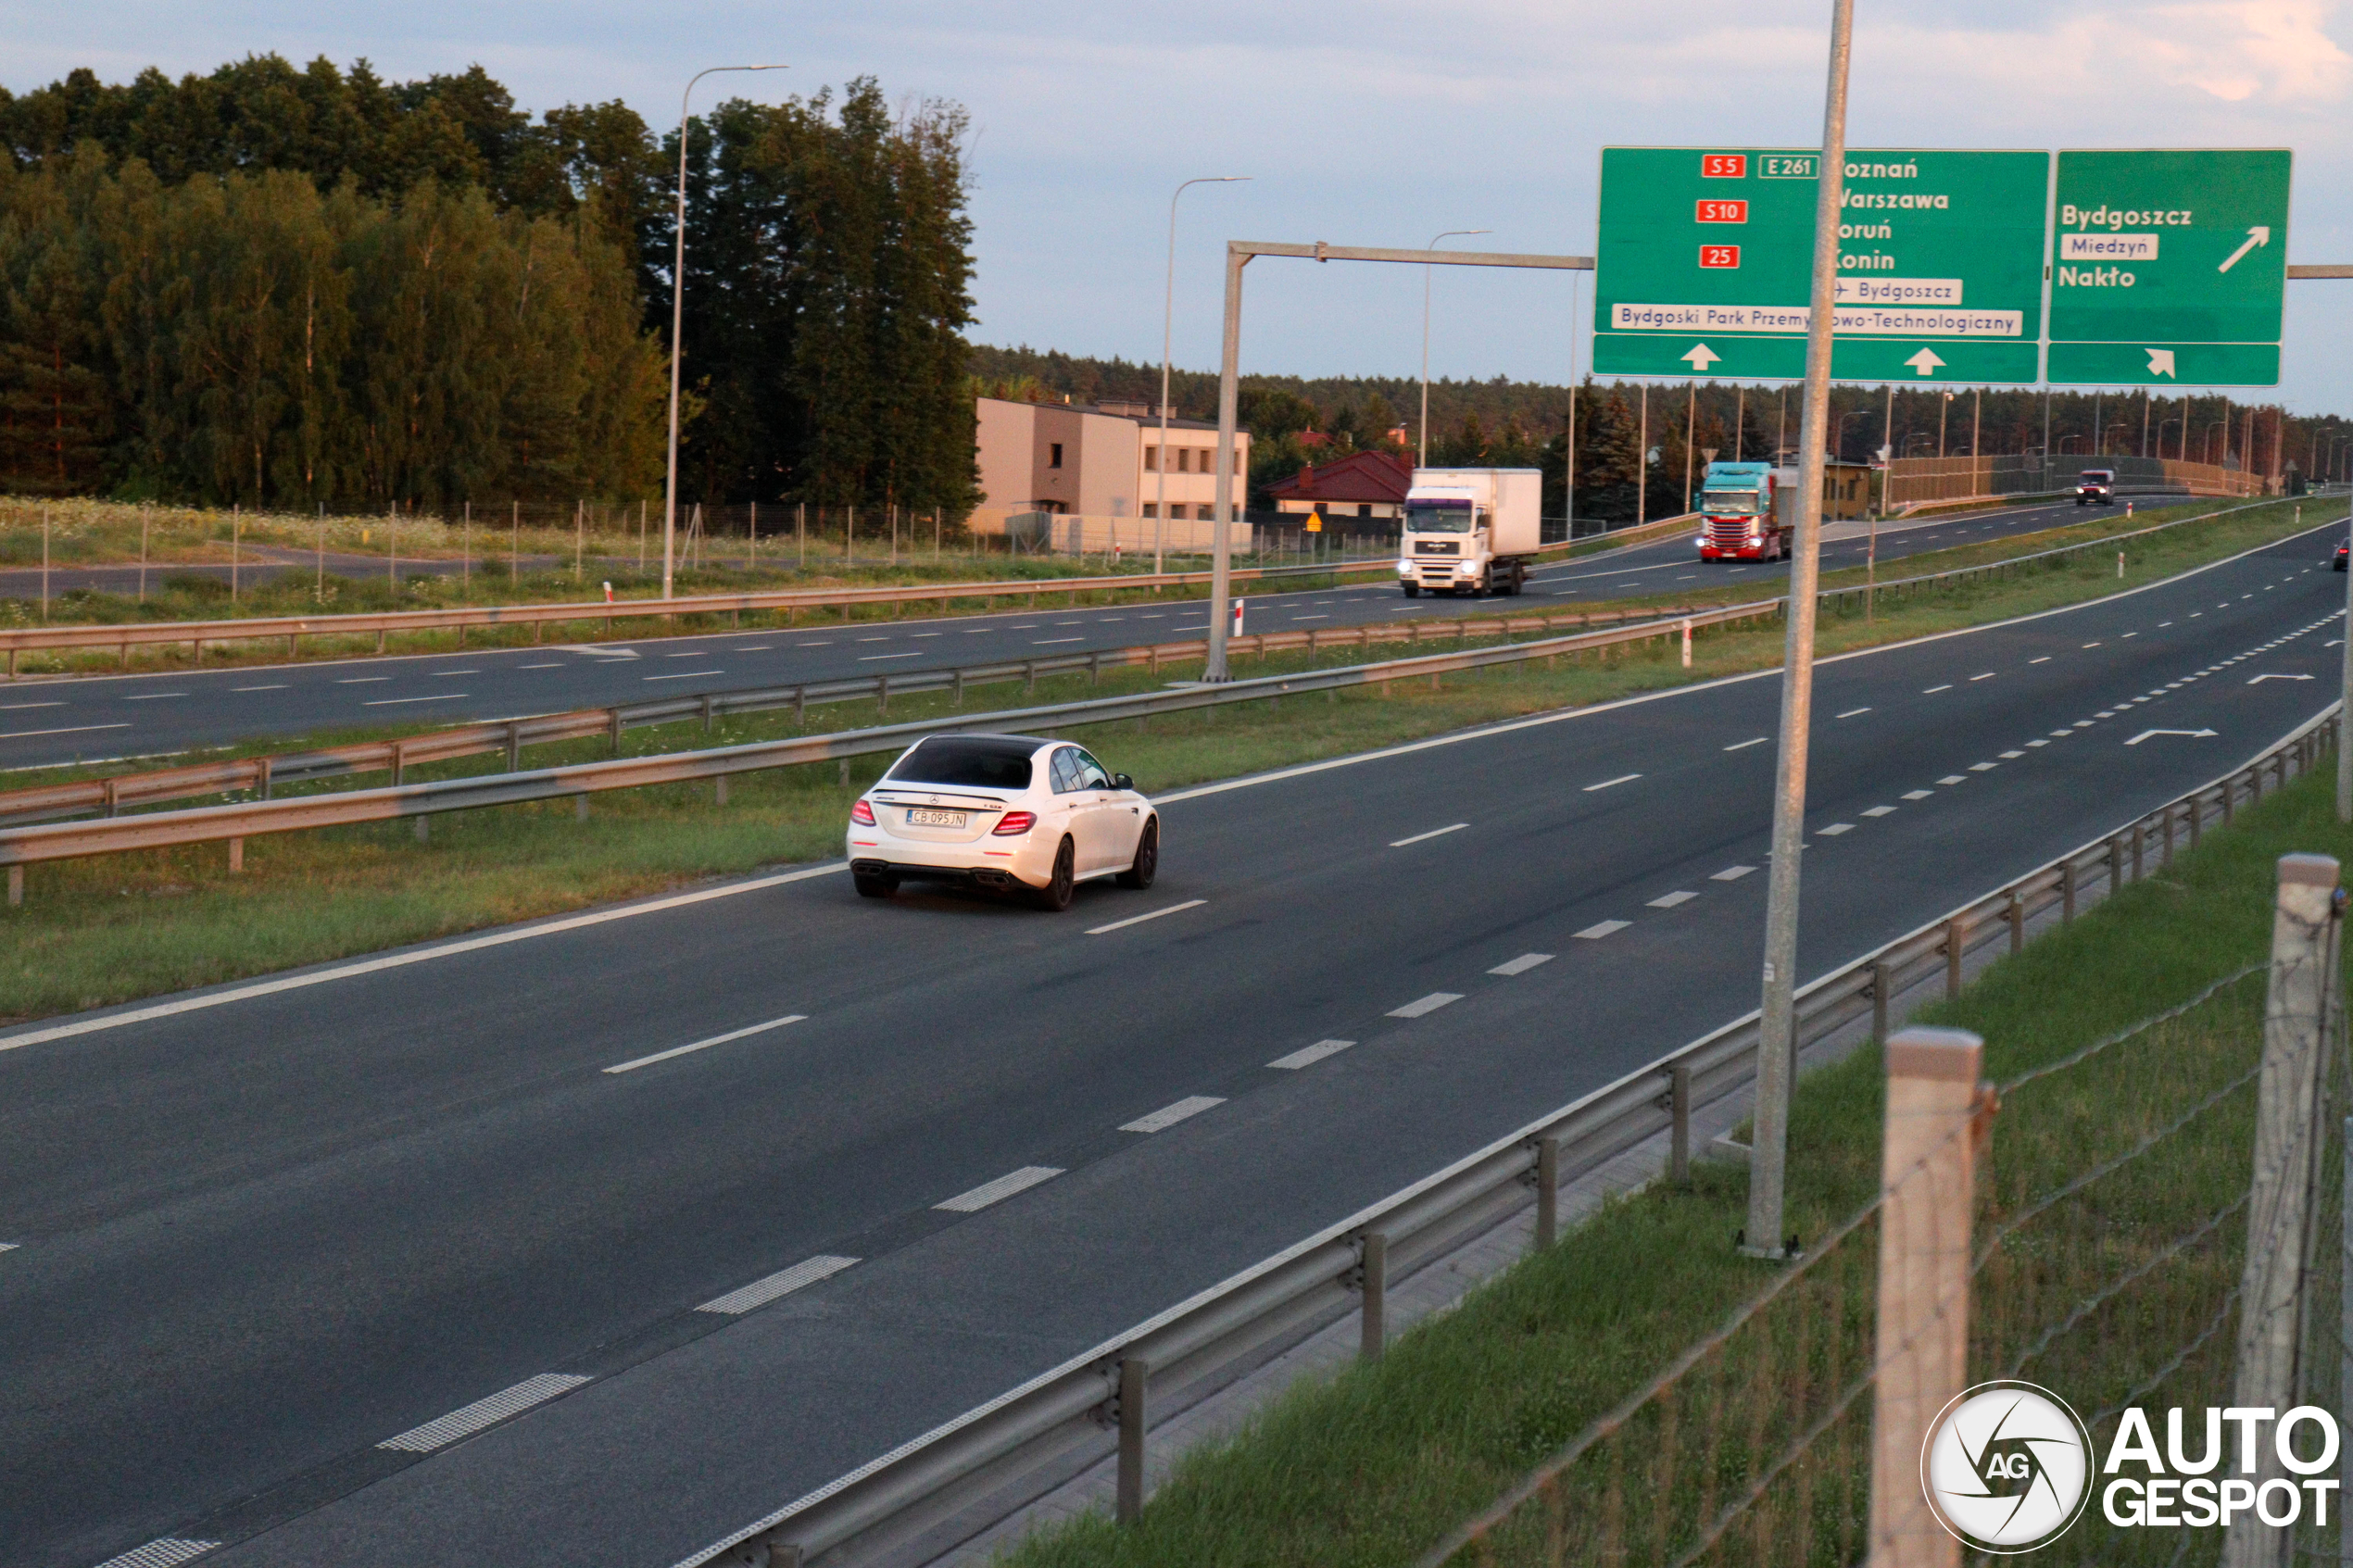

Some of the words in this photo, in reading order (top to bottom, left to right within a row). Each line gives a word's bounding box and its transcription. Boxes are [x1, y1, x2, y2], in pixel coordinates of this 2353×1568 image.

[1711, 158, 1723, 174] S
[1726, 158, 1738, 174] 5
[1767, 159, 1780, 174] E
[1781, 159, 1811, 175] 261
[1843, 157, 1919, 178] oznań
[1705, 204, 1717, 219] S
[1719, 204, 1739, 219] 10
[2061, 204, 2193, 232] Bydgoszcz
[1838, 219, 1893, 239] oruń
[1708, 249, 1731, 264] 25
[2070, 238, 2148, 257] Miedzyń
[2057, 266, 2136, 288] Nakło
[1858, 282, 1952, 301] Bydgoszcz
[1621, 307, 1700, 327] Bydgoski
[1706, 309, 1745, 324] Park
[1751, 310, 2015, 333] Przemyowo-Technologiczny
[913, 811, 927, 822] CB
